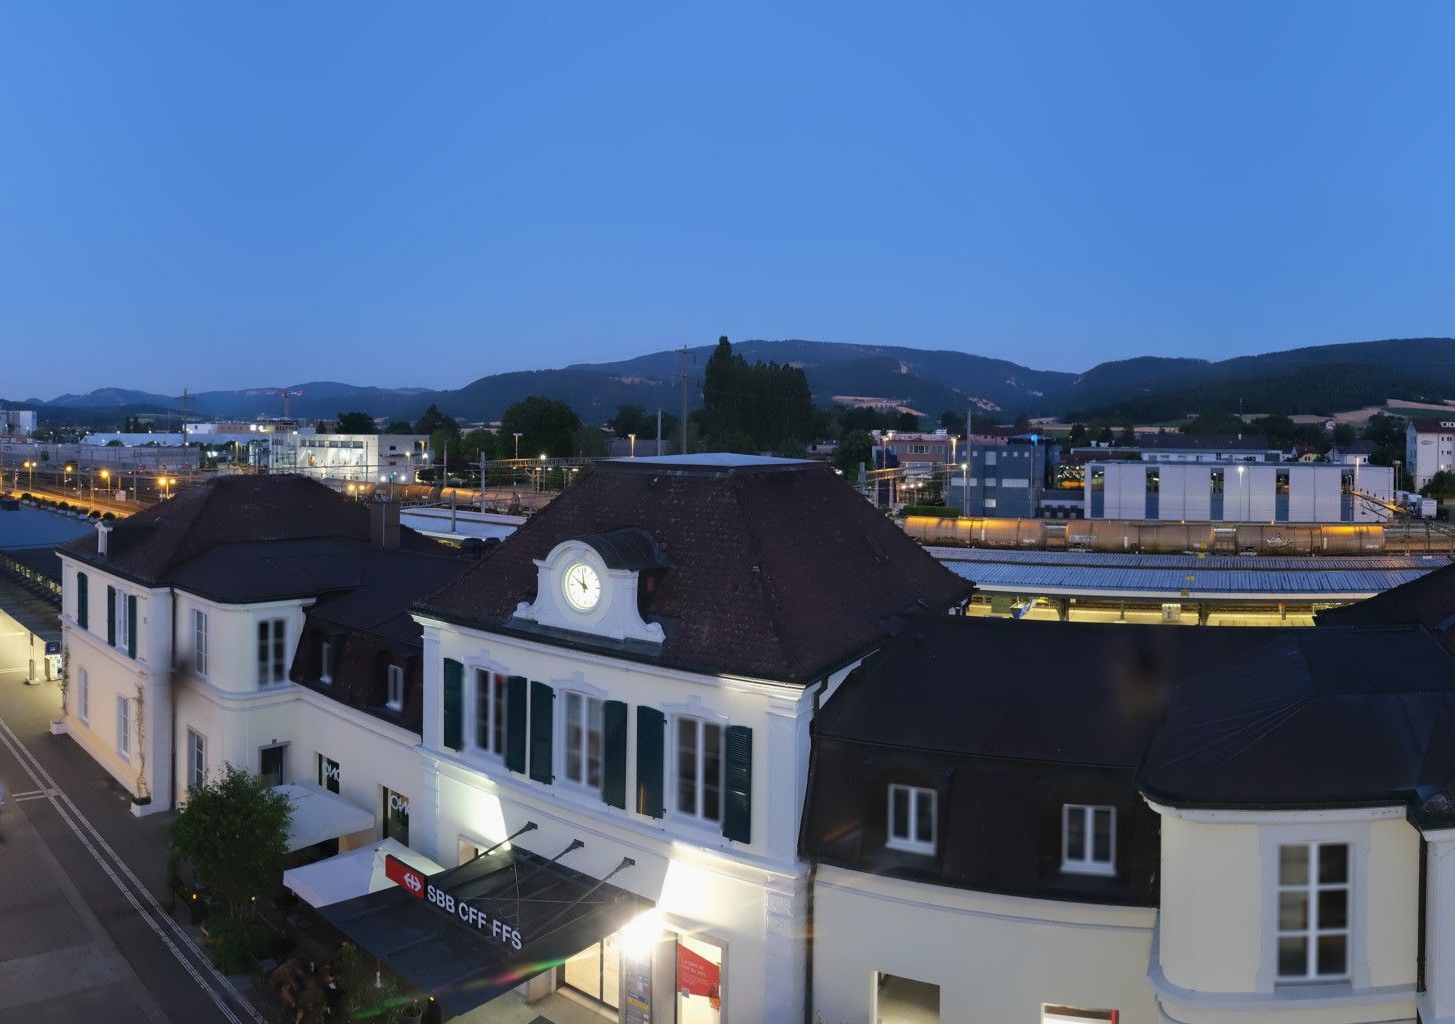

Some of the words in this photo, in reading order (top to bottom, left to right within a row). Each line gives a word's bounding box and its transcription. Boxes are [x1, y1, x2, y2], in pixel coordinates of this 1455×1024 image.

[427, 884, 456, 914] SBB
[458, 902, 487, 929] CFF
[492, 919, 523, 951] FFS
